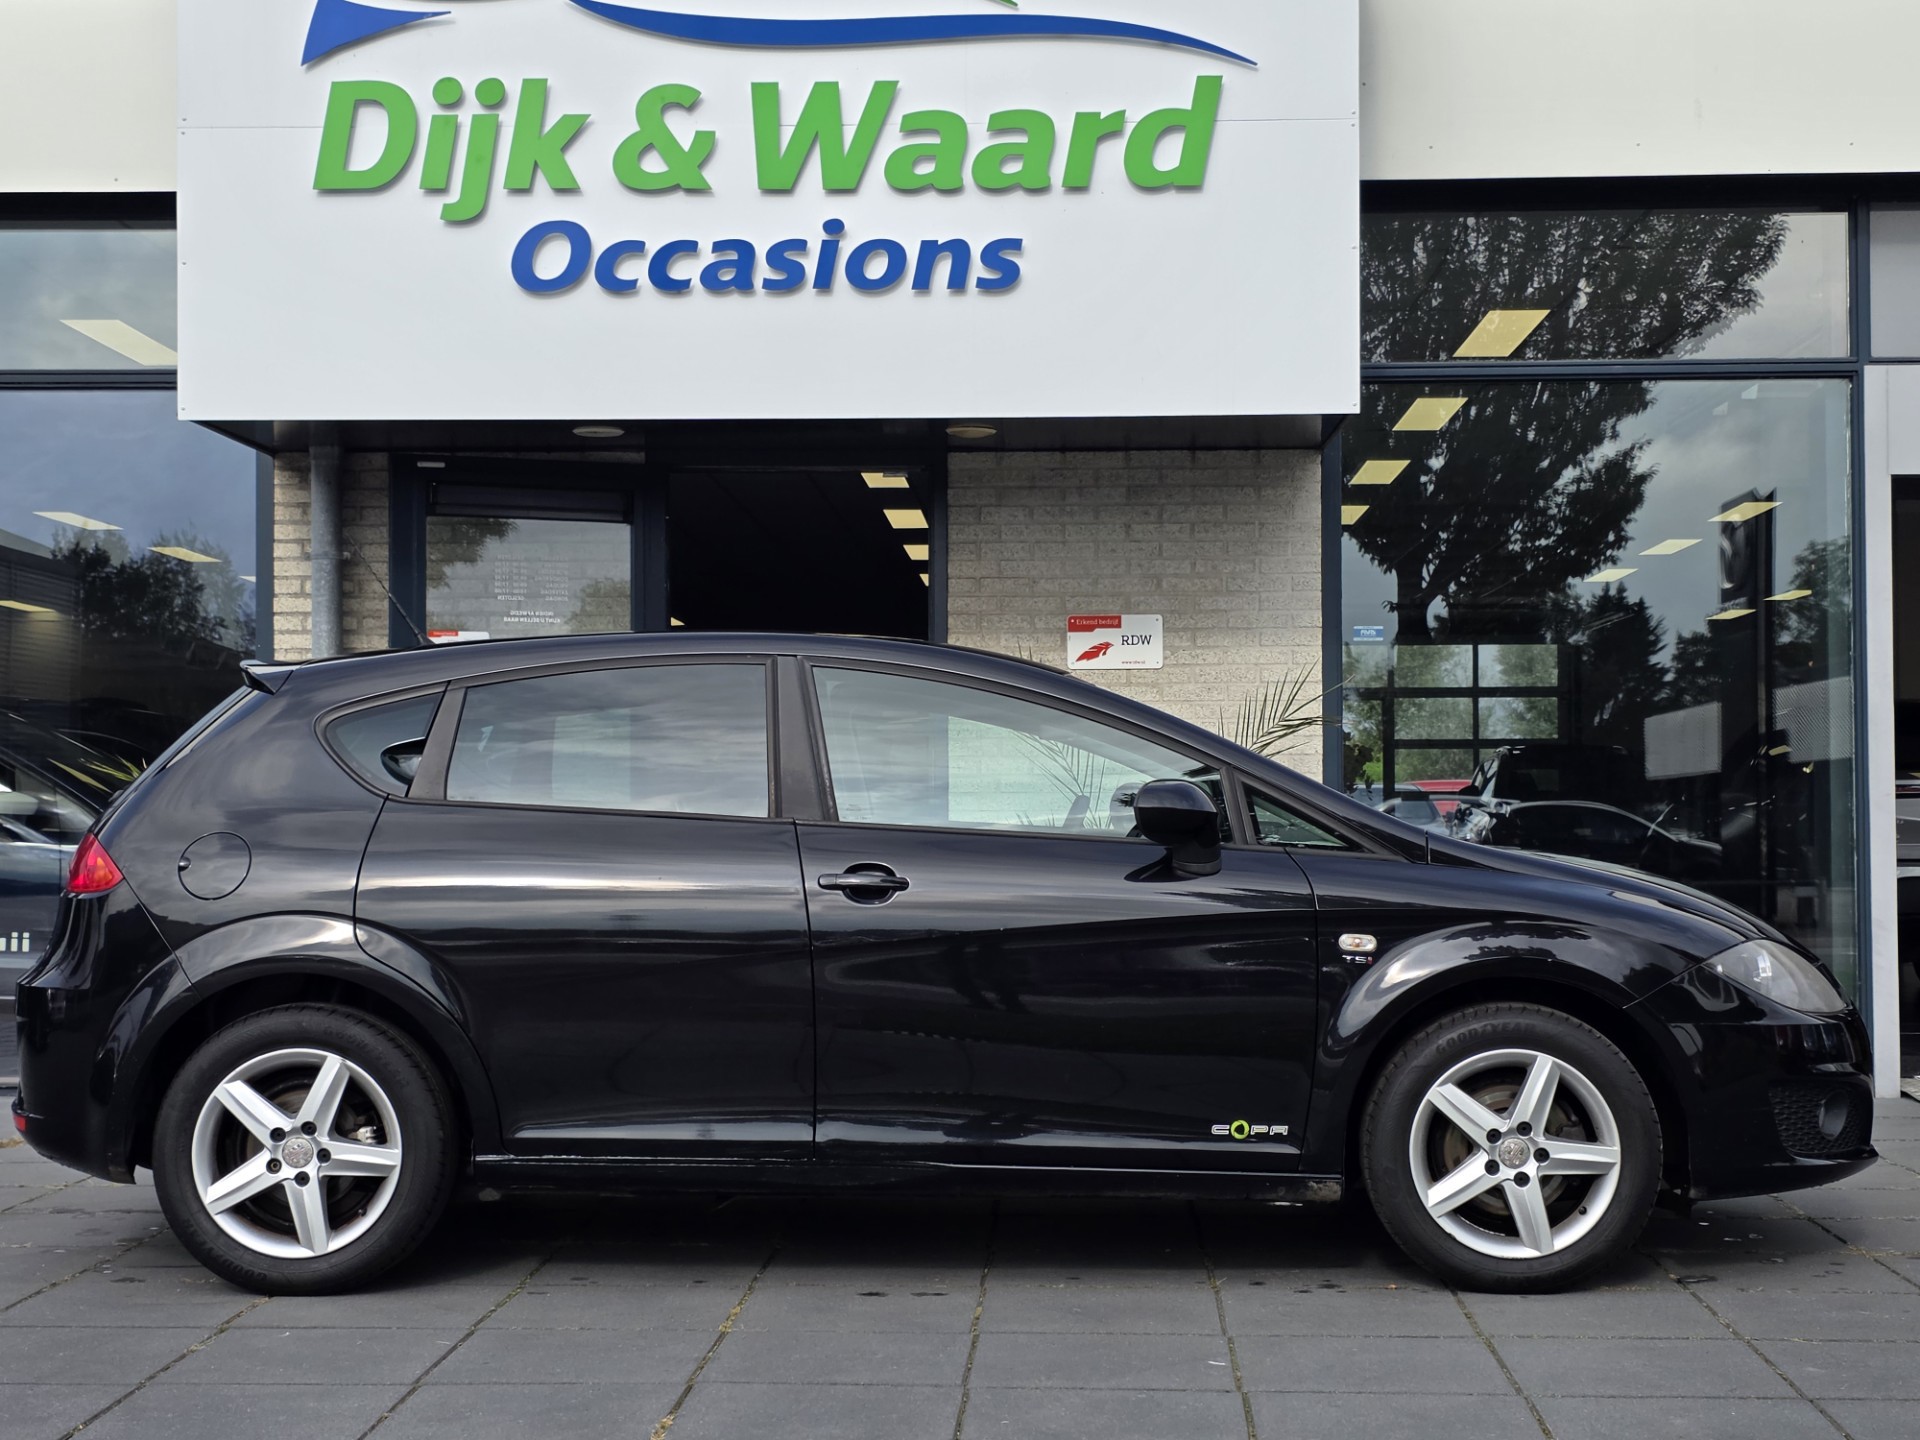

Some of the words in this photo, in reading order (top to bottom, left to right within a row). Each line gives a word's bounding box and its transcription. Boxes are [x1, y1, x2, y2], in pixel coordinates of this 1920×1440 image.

[315, 78, 586, 220] Dijk
[614, 85, 714, 189] &
[752, 76, 1221, 190] Waard
[512, 219, 1021, 291] Occasions
[1121, 634, 1152, 646] RDW
[1211, 1119, 1289, 1140] COPA
